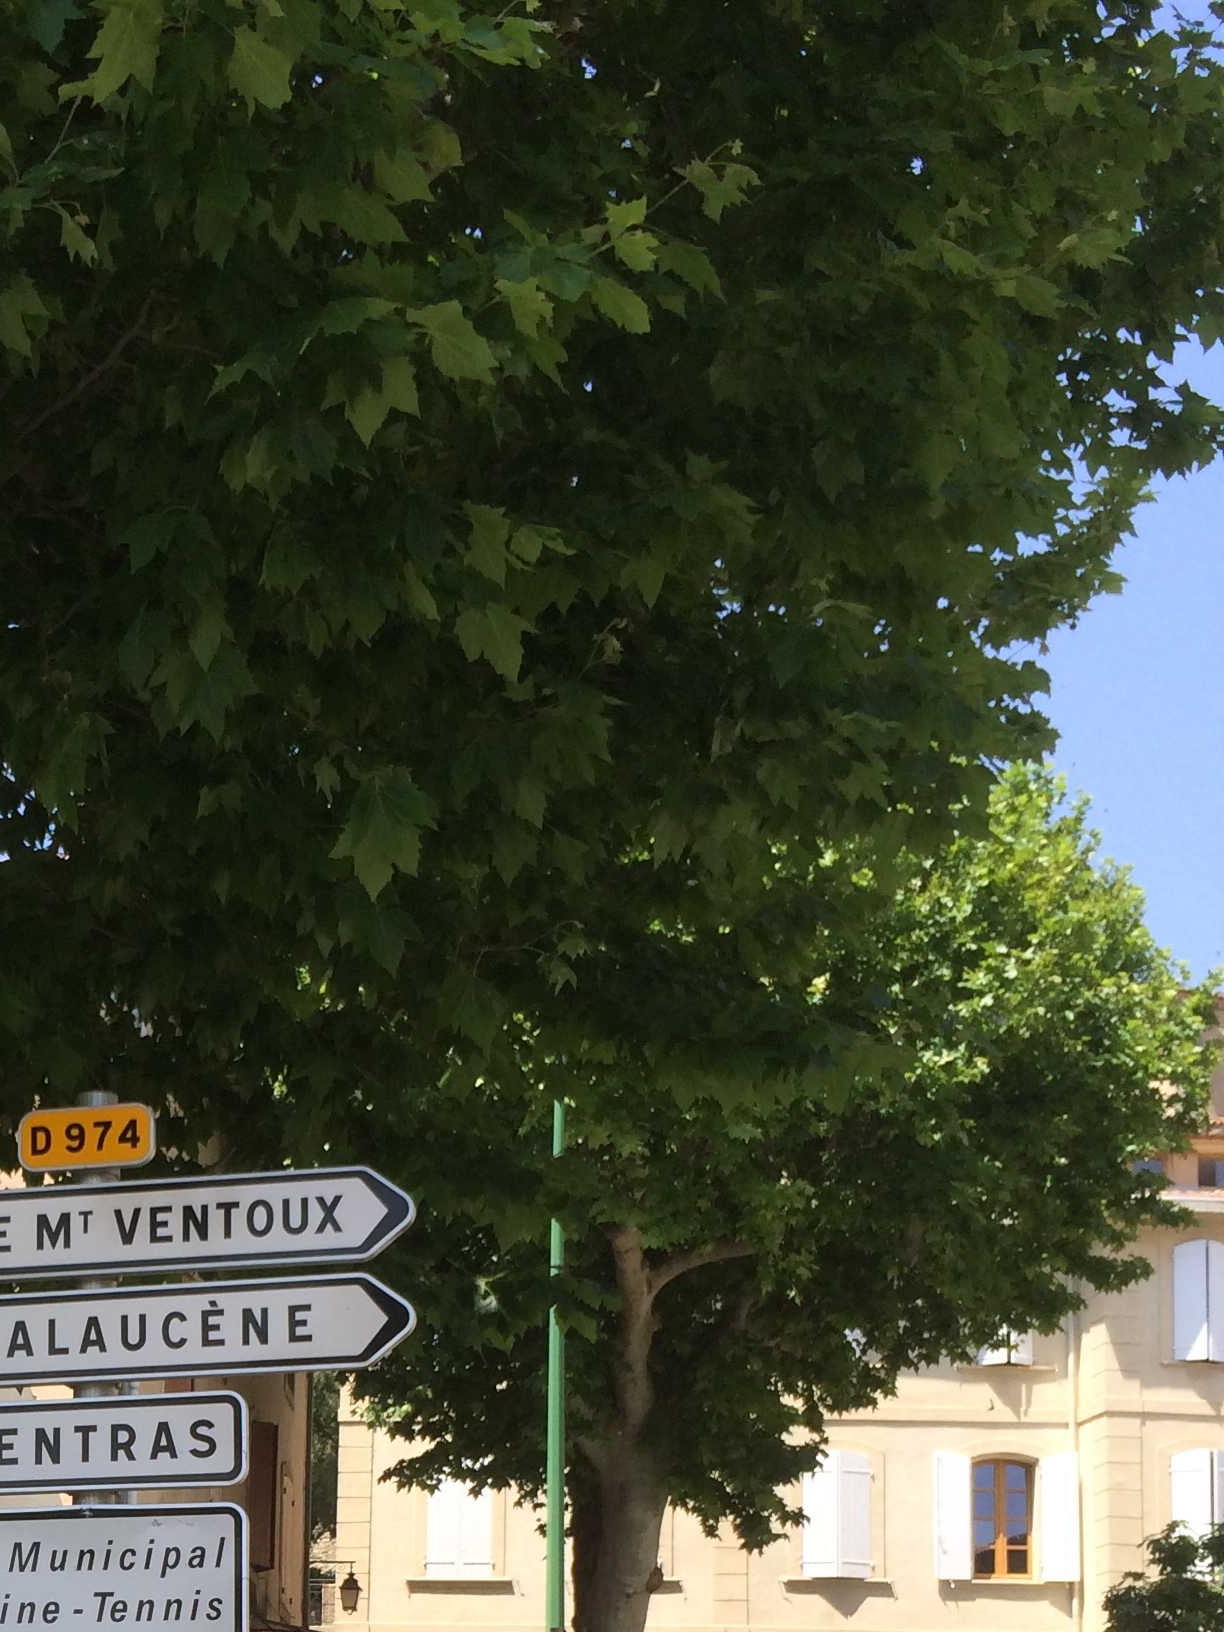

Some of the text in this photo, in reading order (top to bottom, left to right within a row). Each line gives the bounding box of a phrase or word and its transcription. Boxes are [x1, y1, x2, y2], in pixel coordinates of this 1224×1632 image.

[30, 1118, 141, 1156] D 974
[114, 1195, 343, 1246] VENTOUX
[8, 1537, 226, 1578] Municipal
